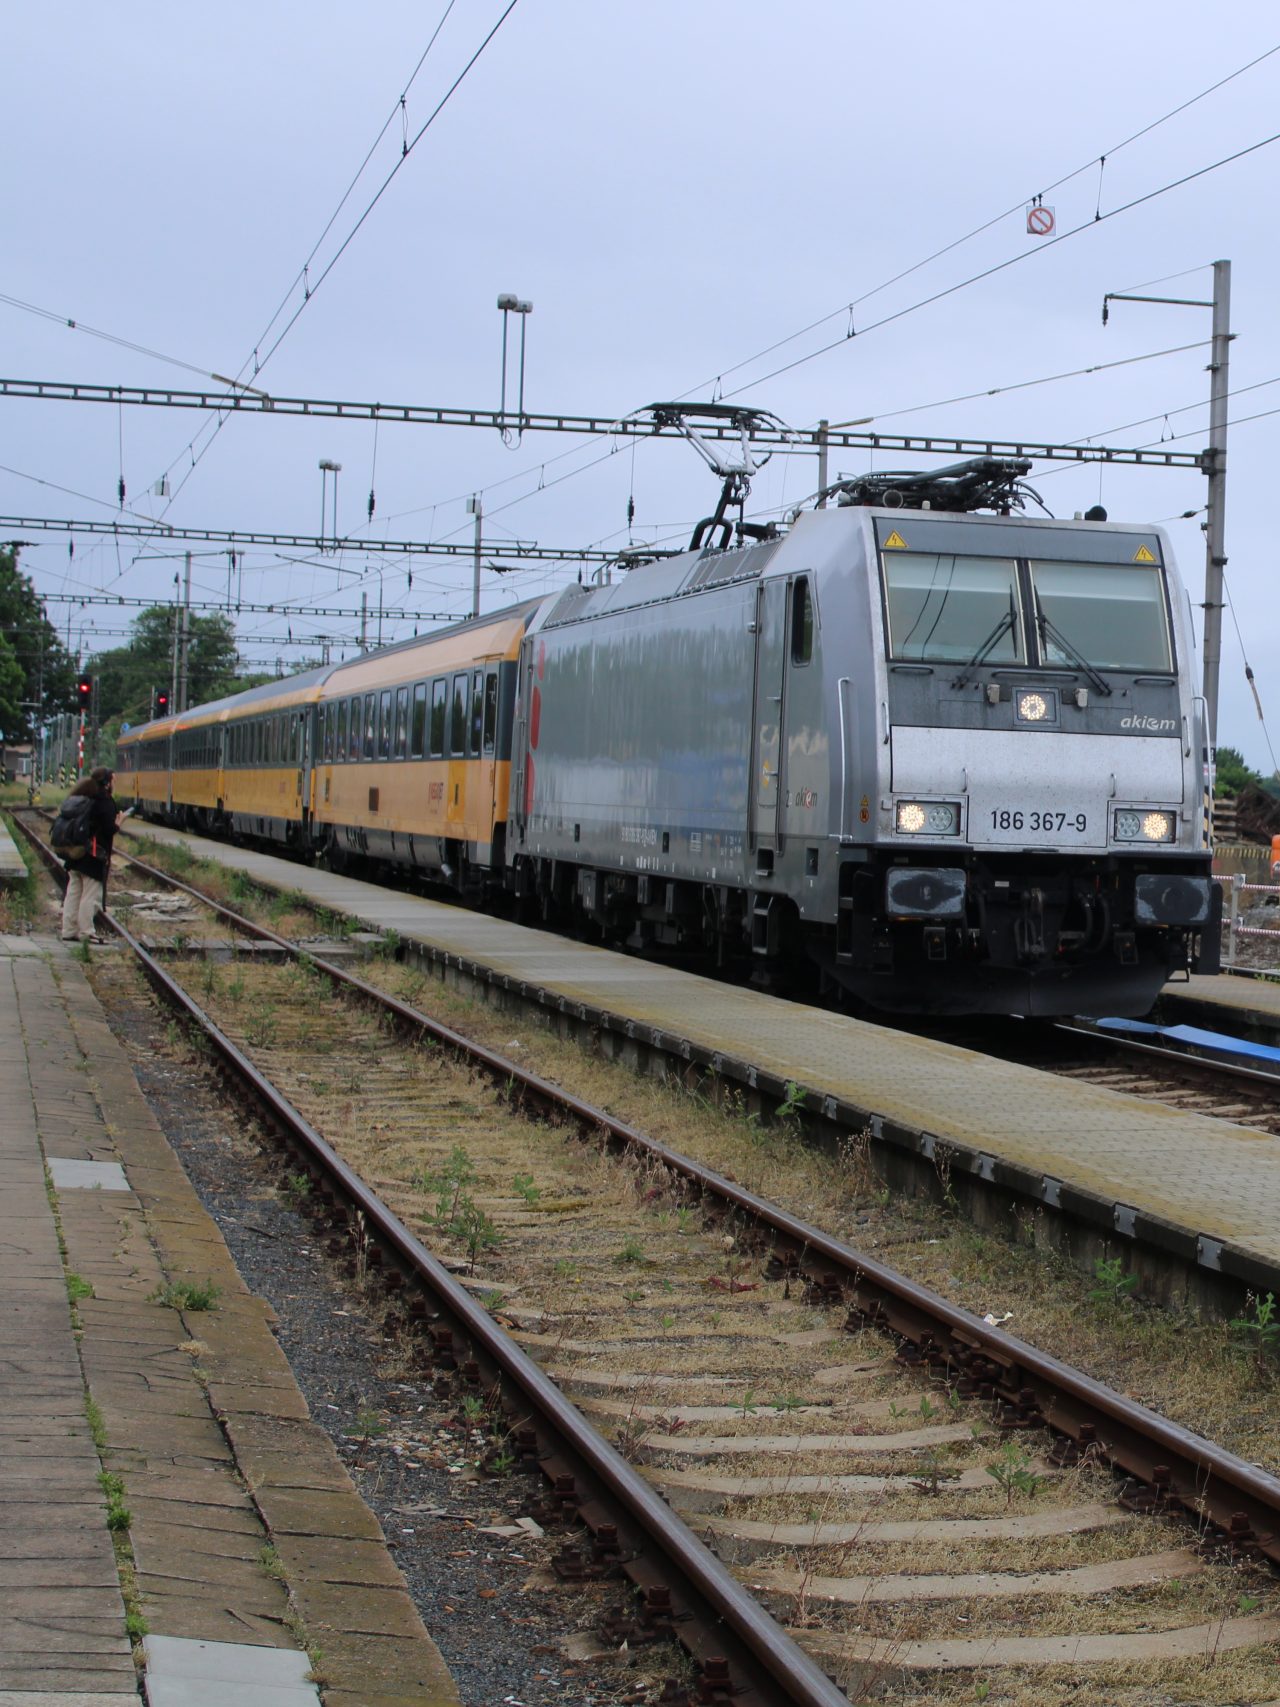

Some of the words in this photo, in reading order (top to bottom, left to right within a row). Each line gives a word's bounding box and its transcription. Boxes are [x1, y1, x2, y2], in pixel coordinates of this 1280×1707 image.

[1120, 715, 1176, 730] akiem
[991, 811, 1024, 830] 186
[1030, 812, 1087, 832] 367-9
